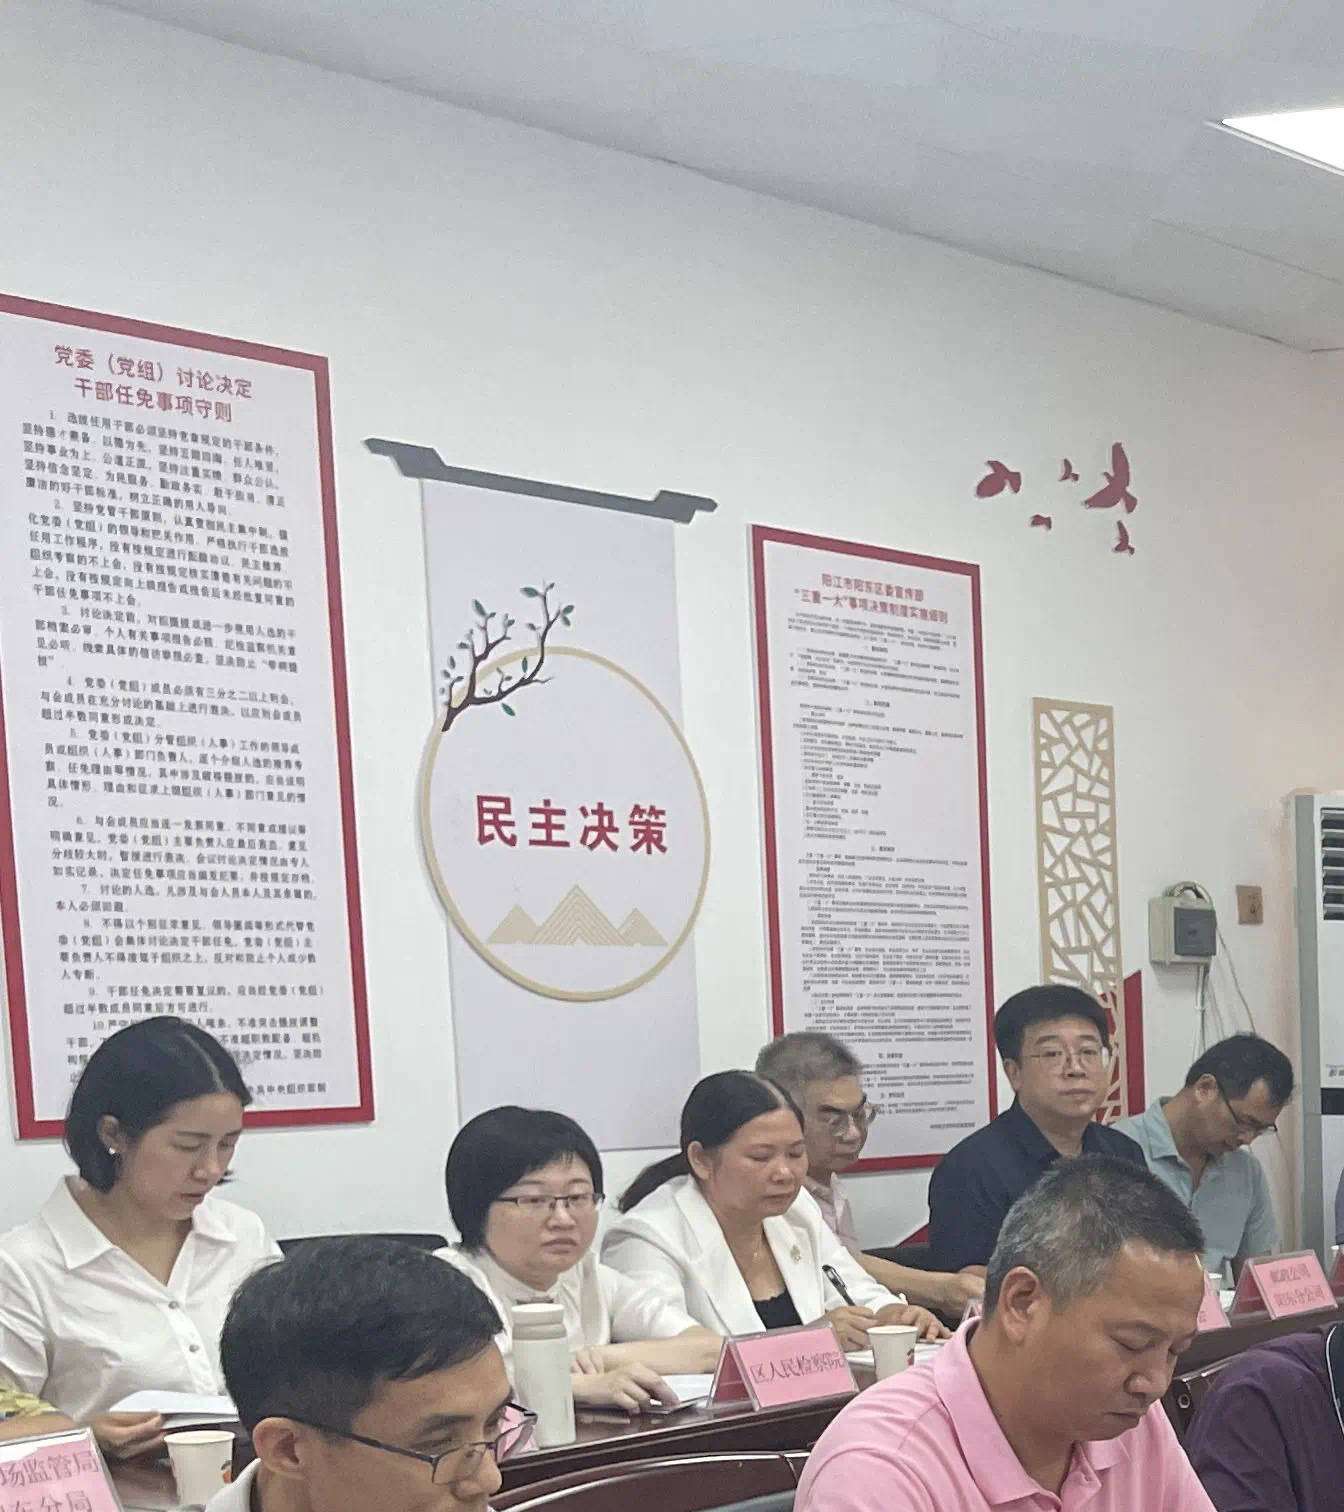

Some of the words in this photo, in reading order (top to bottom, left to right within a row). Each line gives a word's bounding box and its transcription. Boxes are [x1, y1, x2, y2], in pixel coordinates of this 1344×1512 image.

[55, 344, 253, 400] 党委（党组）讨论决定
[75, 377, 233, 423] 干部任免事项守则
[476, 795, 668, 855] 民主决策
[749, 1351, 845, 1383] 区人民检察院
